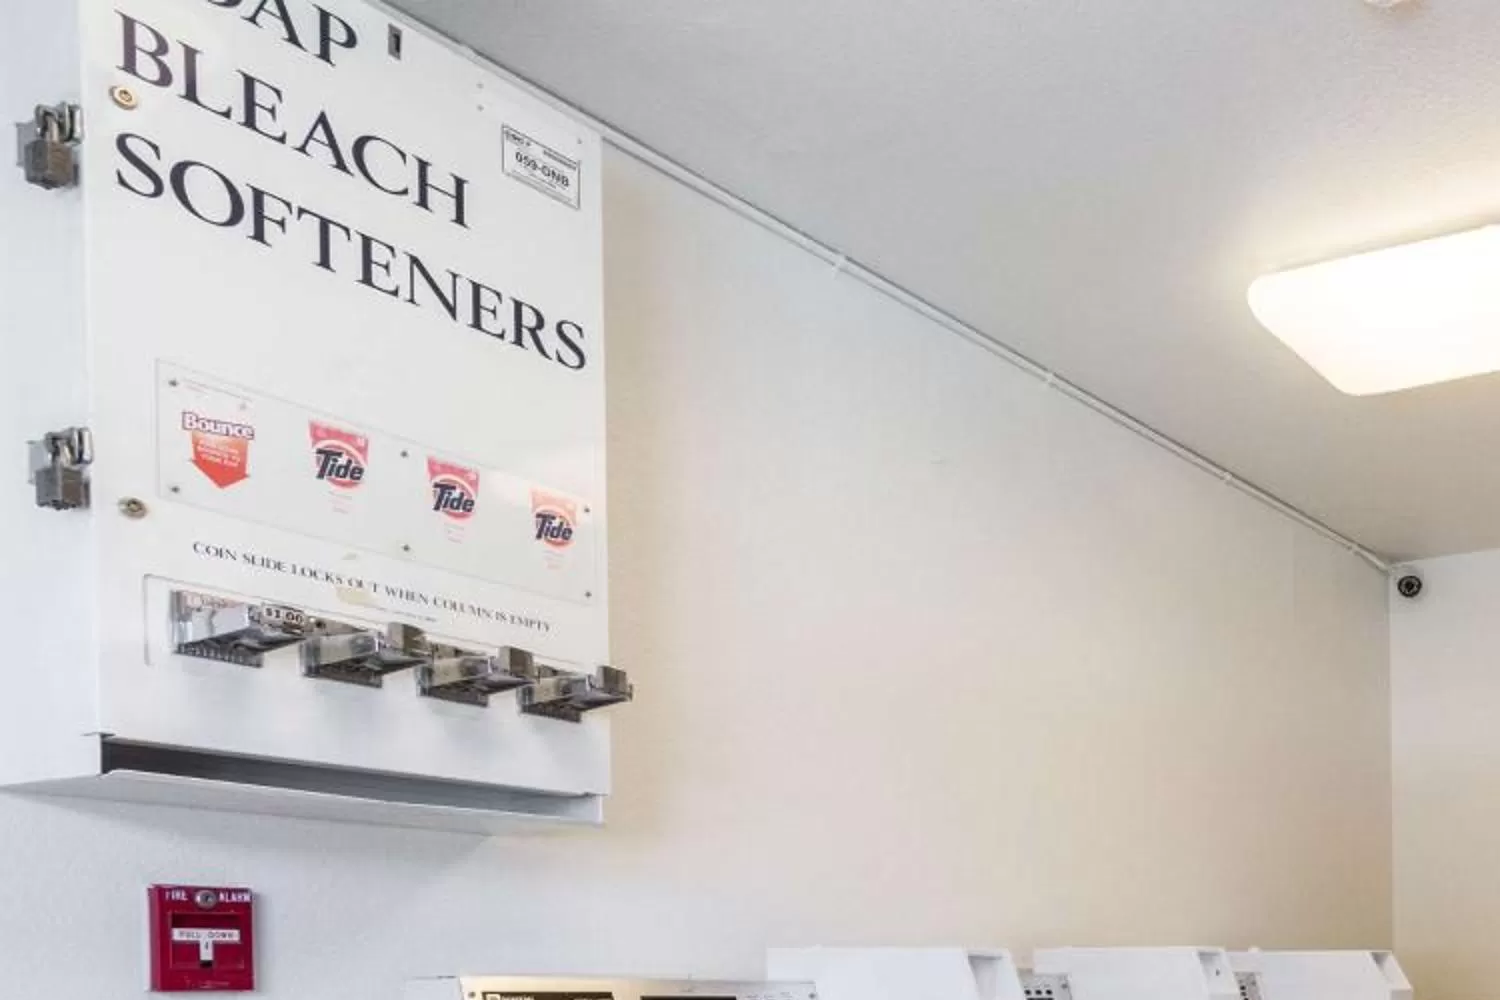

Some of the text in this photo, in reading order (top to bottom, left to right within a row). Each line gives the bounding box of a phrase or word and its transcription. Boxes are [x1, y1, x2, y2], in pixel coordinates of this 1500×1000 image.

[207, 0, 357, 67] AP
[115, 11, 470, 229] BLEACH
[115, 132, 588, 371] SOFTENERS
[182, 412, 254, 440] Bounce
[316, 448, 364, 481] Tide
[433, 481, 475, 513] Tide
[535, 512, 573, 541] Tide
[193, 541, 237, 561] COIN
[242, 553, 287, 573] SLIDE
[292, 563, 342, 585] LOCKS
[347, 577, 379, 593] OUT
[384, 585, 429, 606] WHEN
[433, 597, 493, 619] COLUMN
[495, 611, 508, 623] IS
[509, 615, 551, 632] EMPTY
